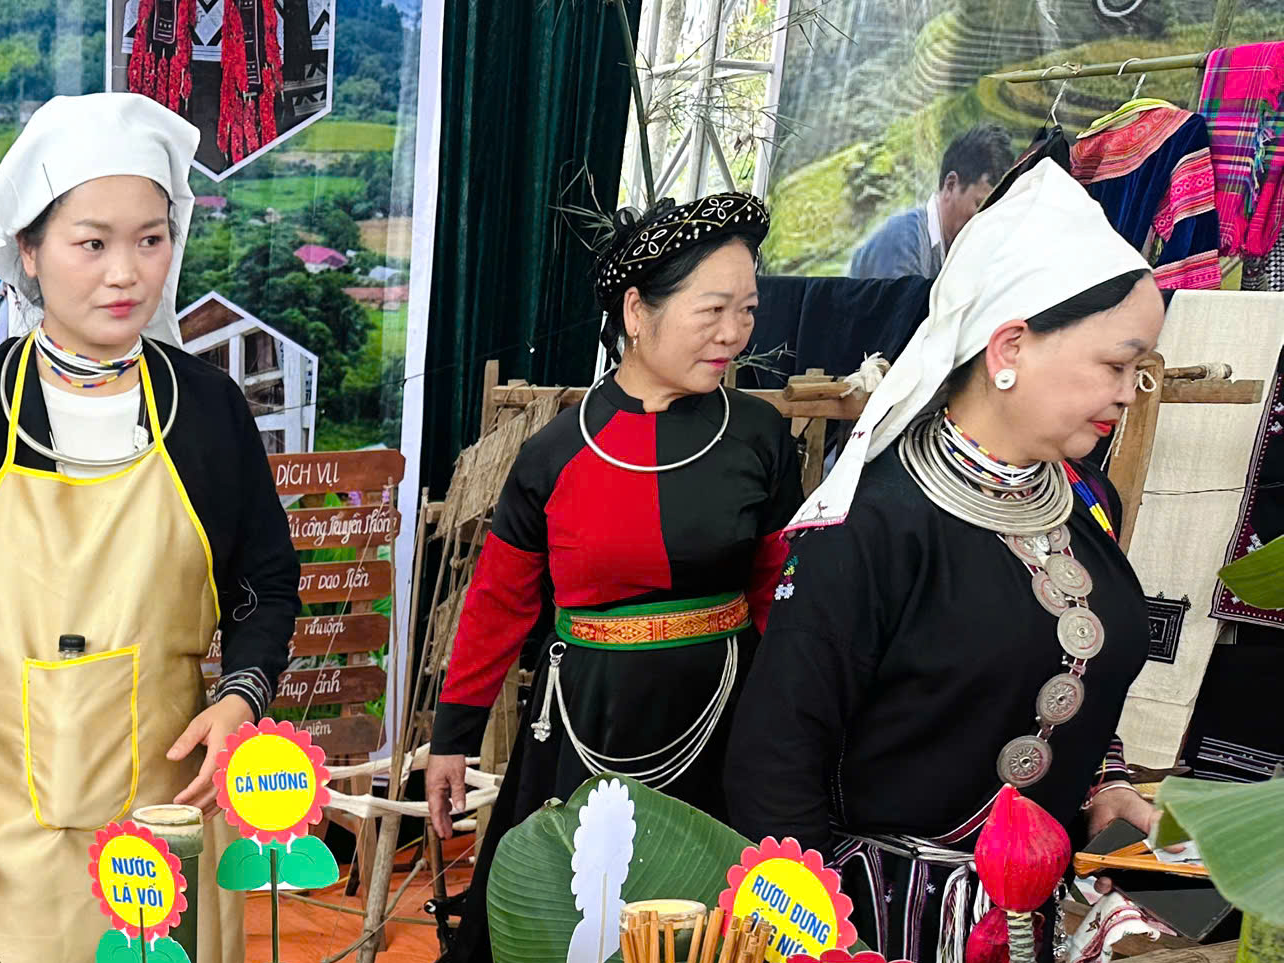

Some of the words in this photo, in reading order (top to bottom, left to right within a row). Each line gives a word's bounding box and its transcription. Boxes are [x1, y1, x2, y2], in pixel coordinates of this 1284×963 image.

[235, 771, 255, 793] CÁ
[257, 769, 308, 792] NƯỚNG
[111, 855, 157, 879] NƯỚC
[112, 881, 133, 905] LÁ
[136, 882, 164, 908] VỐI
[751, 873, 792, 914] RƯỢU
[788, 901, 831, 946] ĐỰNG
